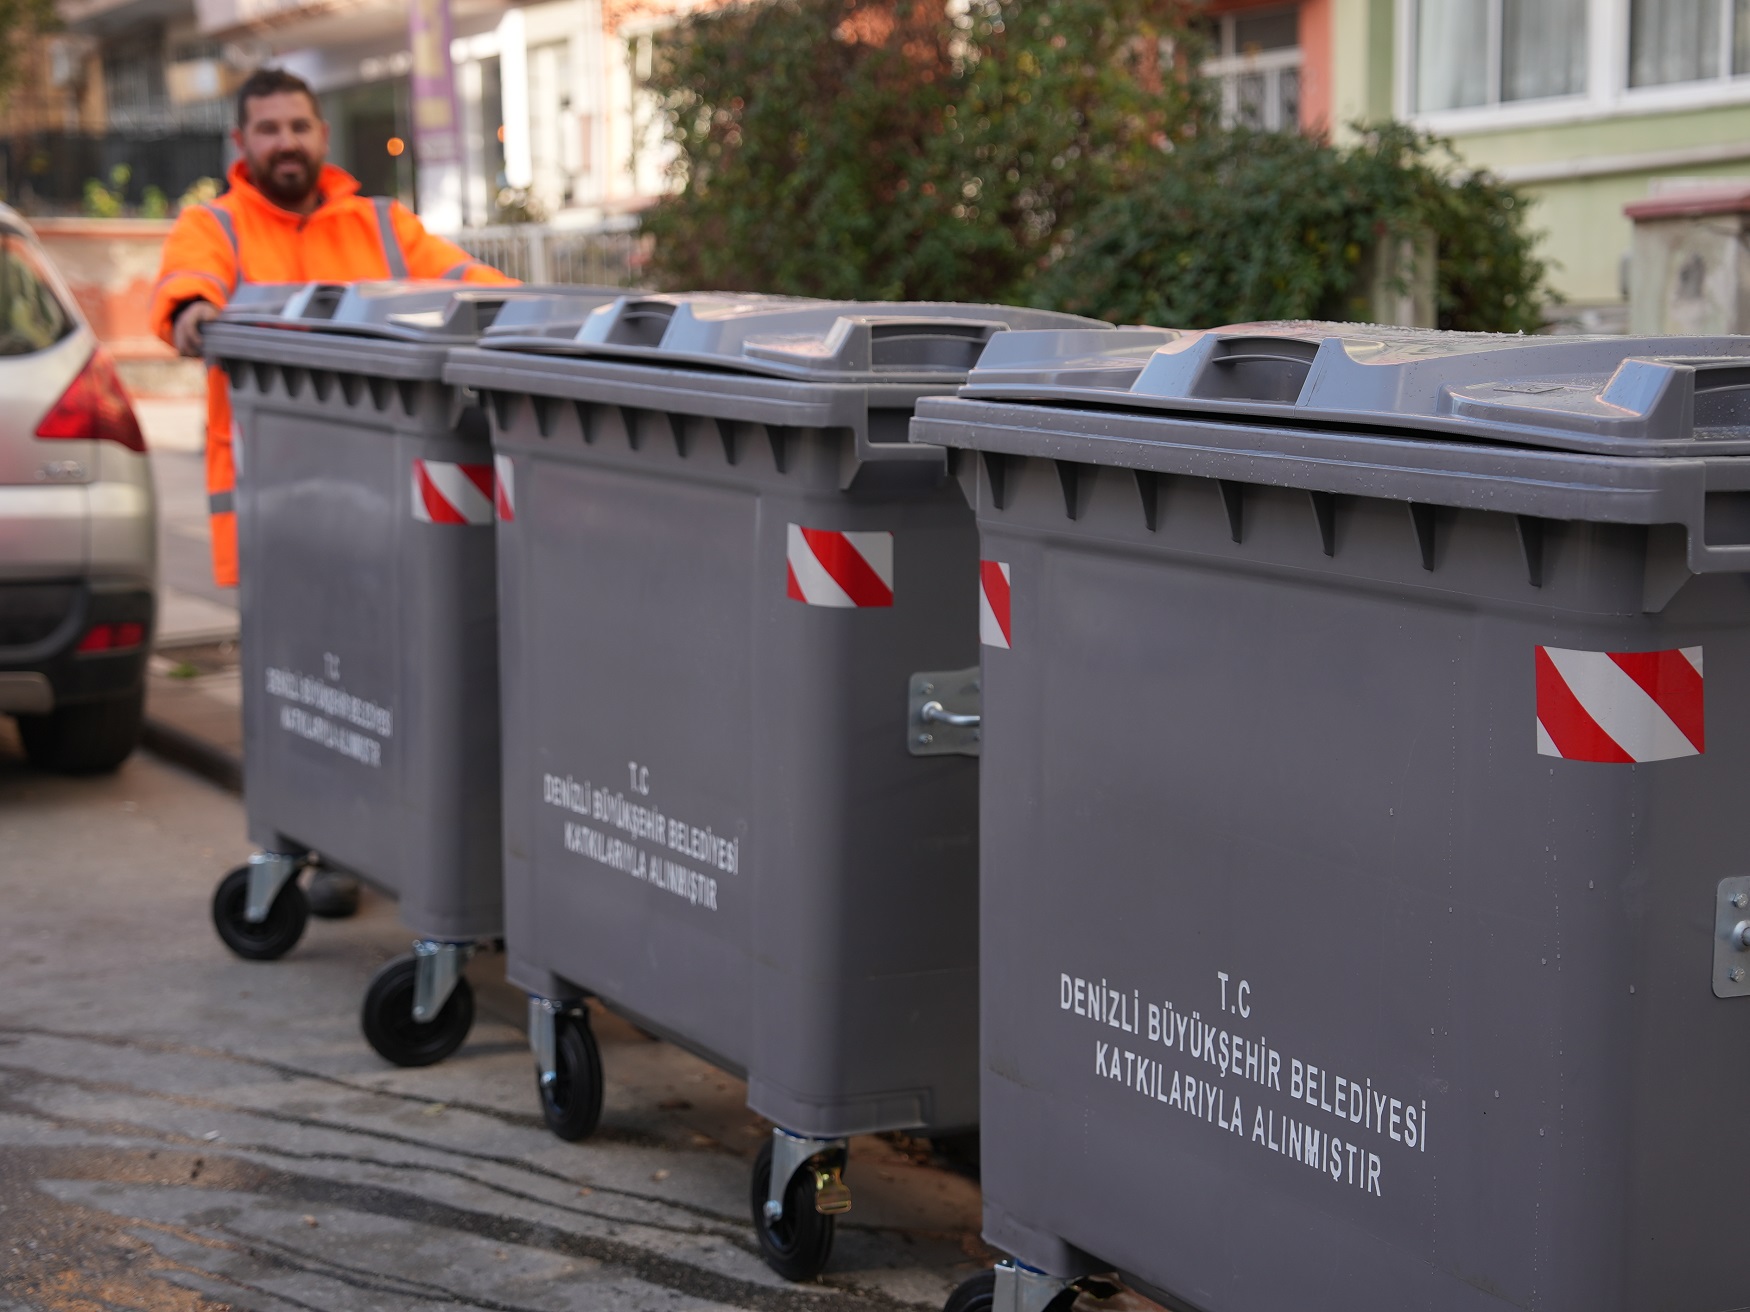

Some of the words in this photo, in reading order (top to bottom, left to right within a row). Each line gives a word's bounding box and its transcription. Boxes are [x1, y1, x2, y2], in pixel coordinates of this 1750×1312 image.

[1060, 972, 1139, 1035] DENİZLİ
[1148, 1001, 1281, 1091] BÜYÜKŞEHİR
[1290, 1057, 1427, 1152] BELEDİYESİ
[1217, 971, 1251, 1019] T.C
[1096, 1040, 1244, 1137] KATKILARIYLA
[1252, 1105, 1382, 1197] ALINMIŞTIR
